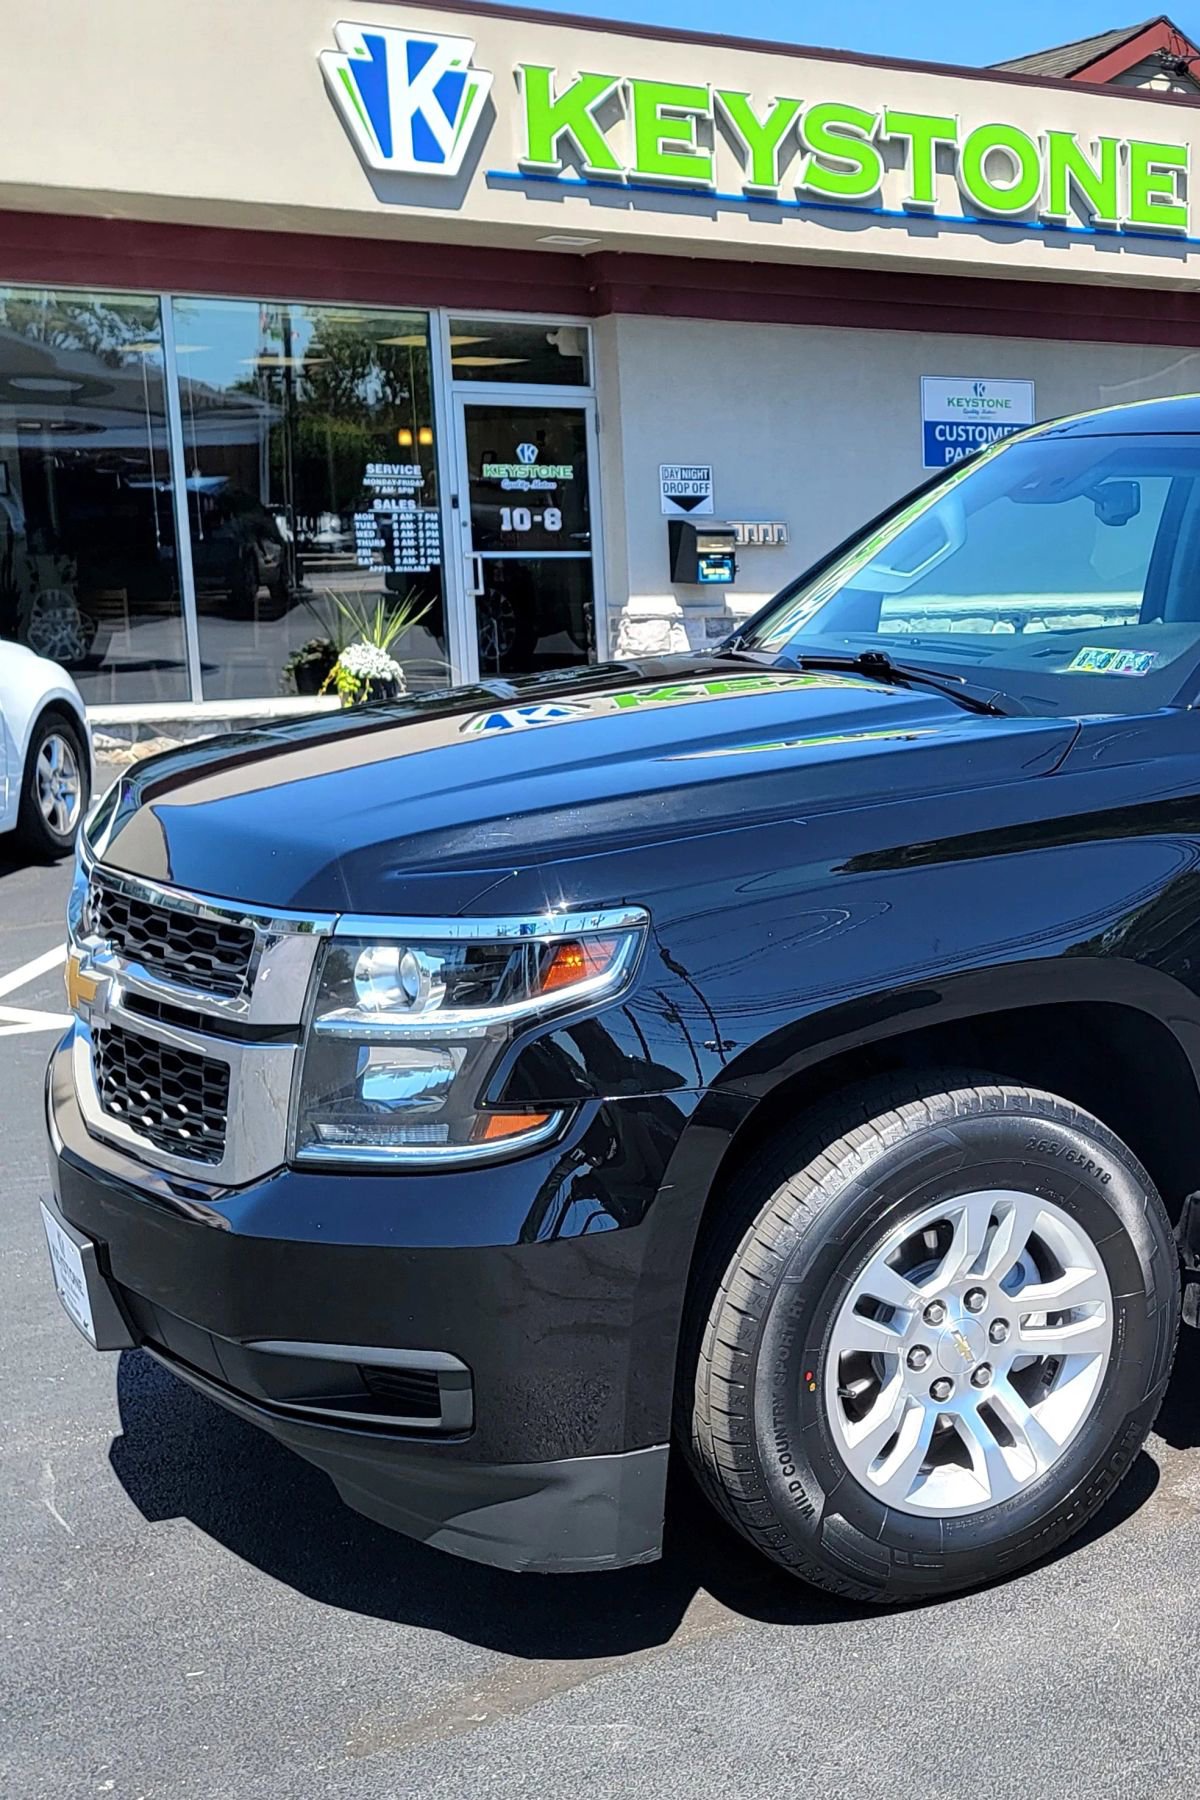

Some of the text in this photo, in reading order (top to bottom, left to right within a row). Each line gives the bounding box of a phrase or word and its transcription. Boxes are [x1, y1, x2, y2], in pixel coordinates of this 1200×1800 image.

[517, 63, 1189, 232] KEYSTONE
[947, 396, 1012, 409] KEYSTONE
[366, 463, 421, 475] SERVICE
[483, 464, 574, 479] KEYSTONE
[663, 468, 710, 480] DAY NIGHT
[663, 482, 711, 494] DROP OFF
[373, 499, 417, 510] SALES
[354, 512, 375, 520] MON
[425, 512, 438, 520] PM
[355, 530, 375, 538] WED
[426, 530, 439, 538] PM
[357, 548, 371, 556] FRI
[426, 548, 440, 556] PM
[358, 557, 374, 565] SAT
[427, 557, 440, 565] PM
[1025, 1136, 1112, 1185] 265/65R18
[772, 1395, 796, 1478] COUNTRY
[789, 1480, 816, 1521] WILD
